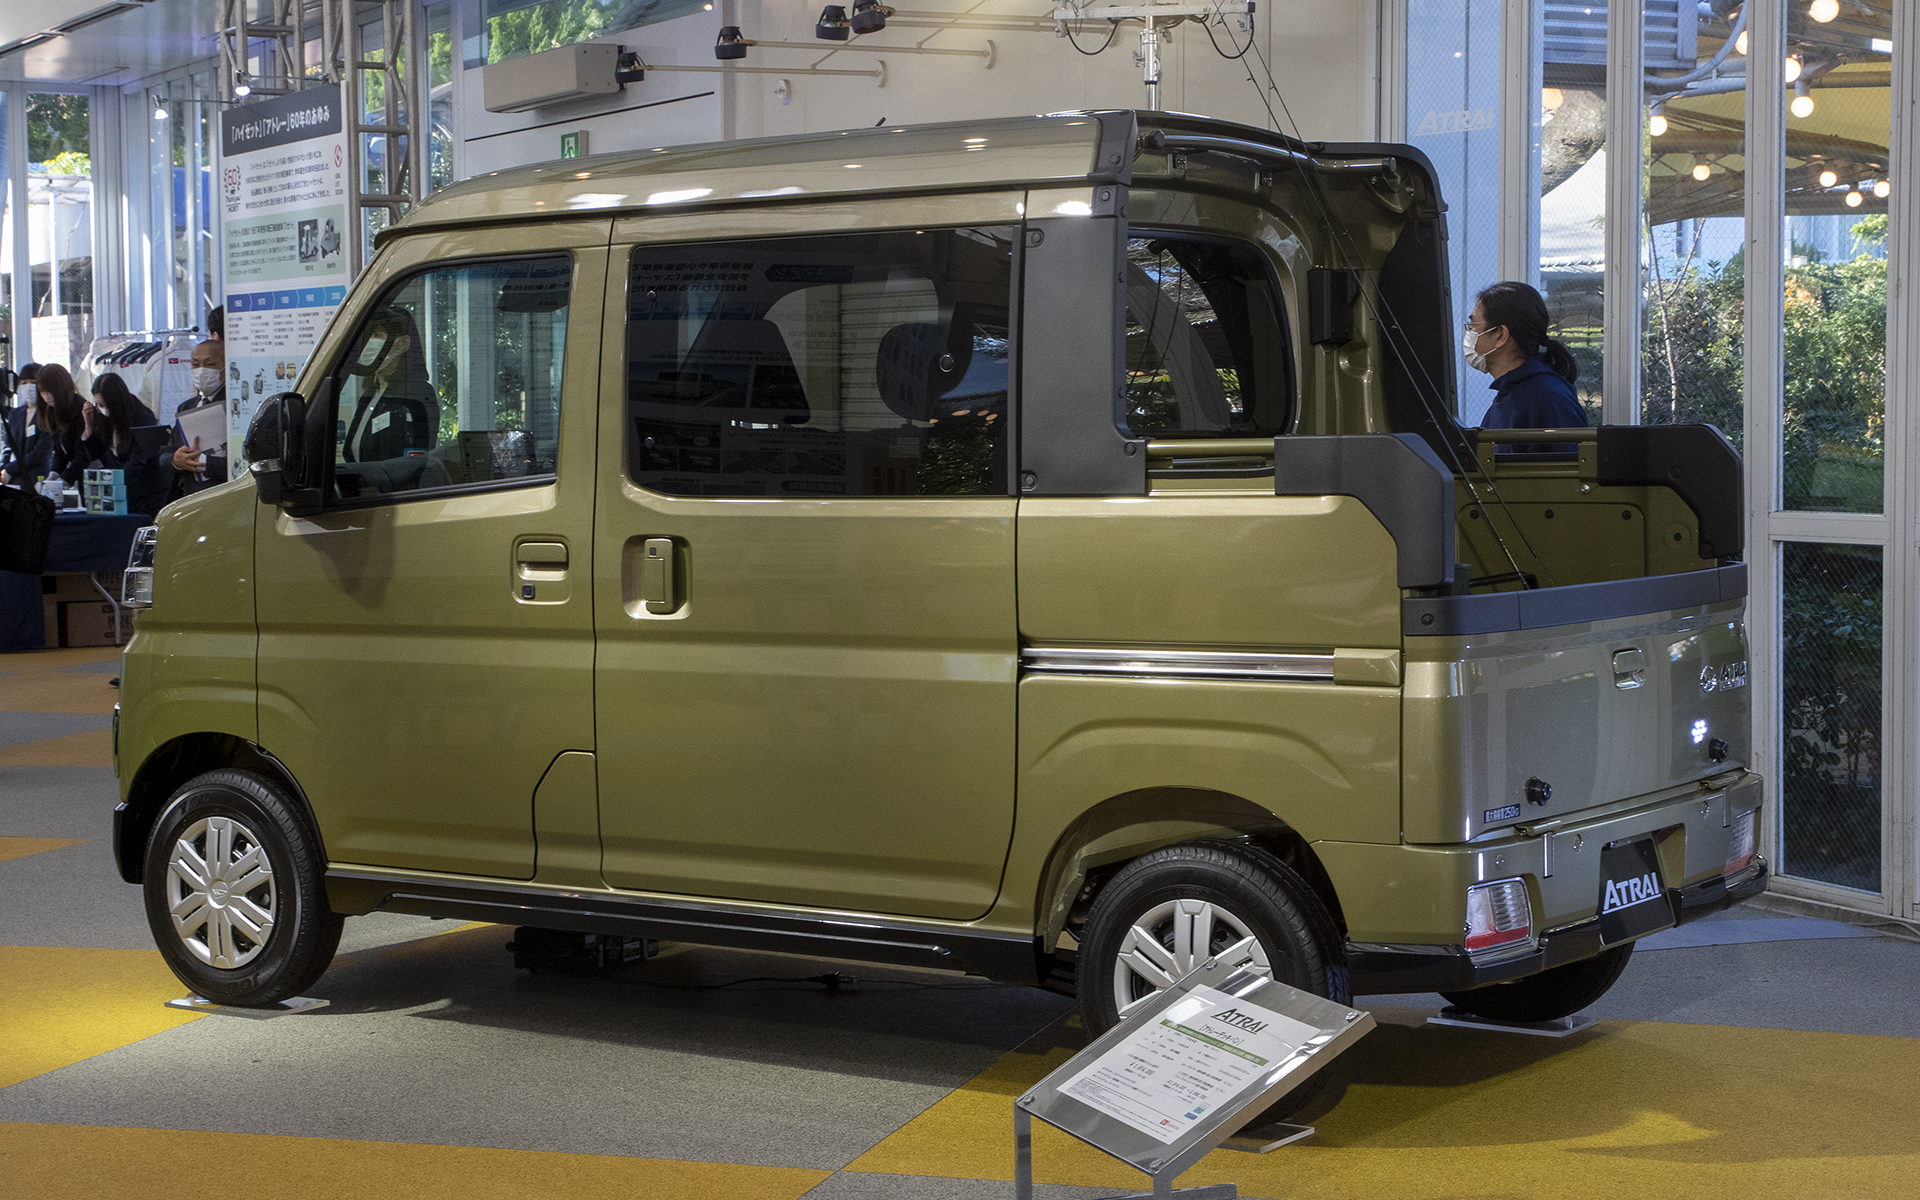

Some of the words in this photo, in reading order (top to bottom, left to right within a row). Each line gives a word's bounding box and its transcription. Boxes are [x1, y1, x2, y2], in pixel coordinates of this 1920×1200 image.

[232, 105, 330, 144] 「ハイゼット」「アトレー」60年のあゆみ
[1415, 108, 1494, 134] ATRAI
[228, 168, 237, 186] 60
[98, 570, 121, 581] HIJE
[1603, 872, 1660, 911] ATRAI
[1212, 1007, 1269, 1034] ATRAI
